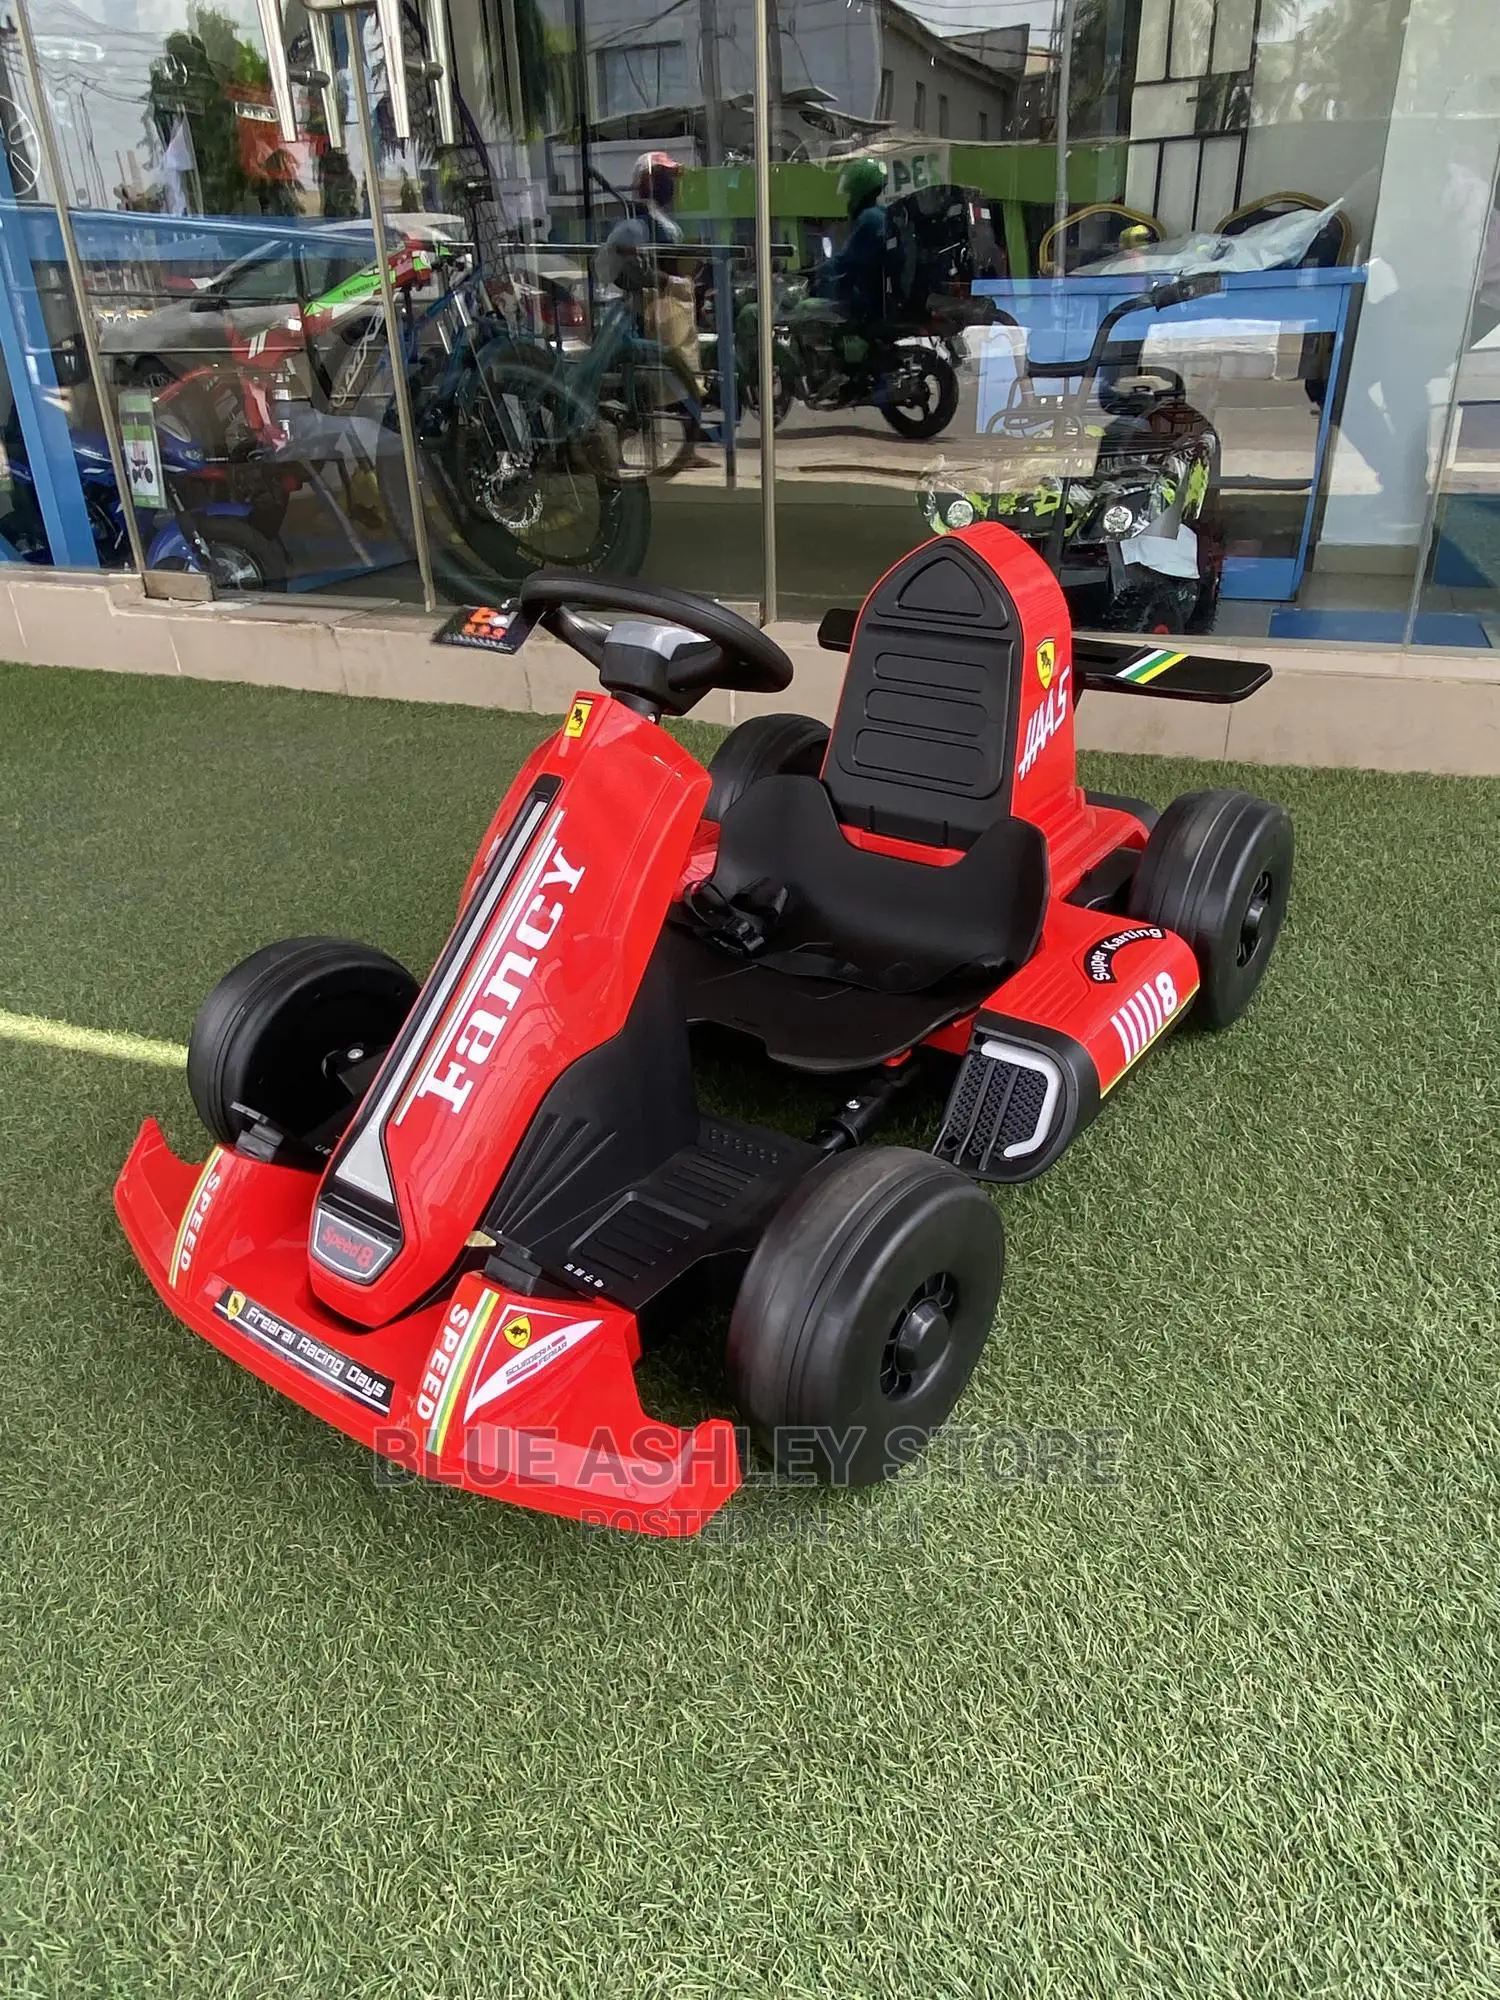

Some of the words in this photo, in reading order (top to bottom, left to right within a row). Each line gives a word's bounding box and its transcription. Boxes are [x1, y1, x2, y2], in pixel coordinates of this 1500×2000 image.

[1101, 928, 1162, 951] Karting
[180, 1171, 220, 1272] SPEED
[296, 1337, 345, 1377] Racing
[345, 1365, 387, 1398] Days
[416, 1303, 470, 1421] SPEED
